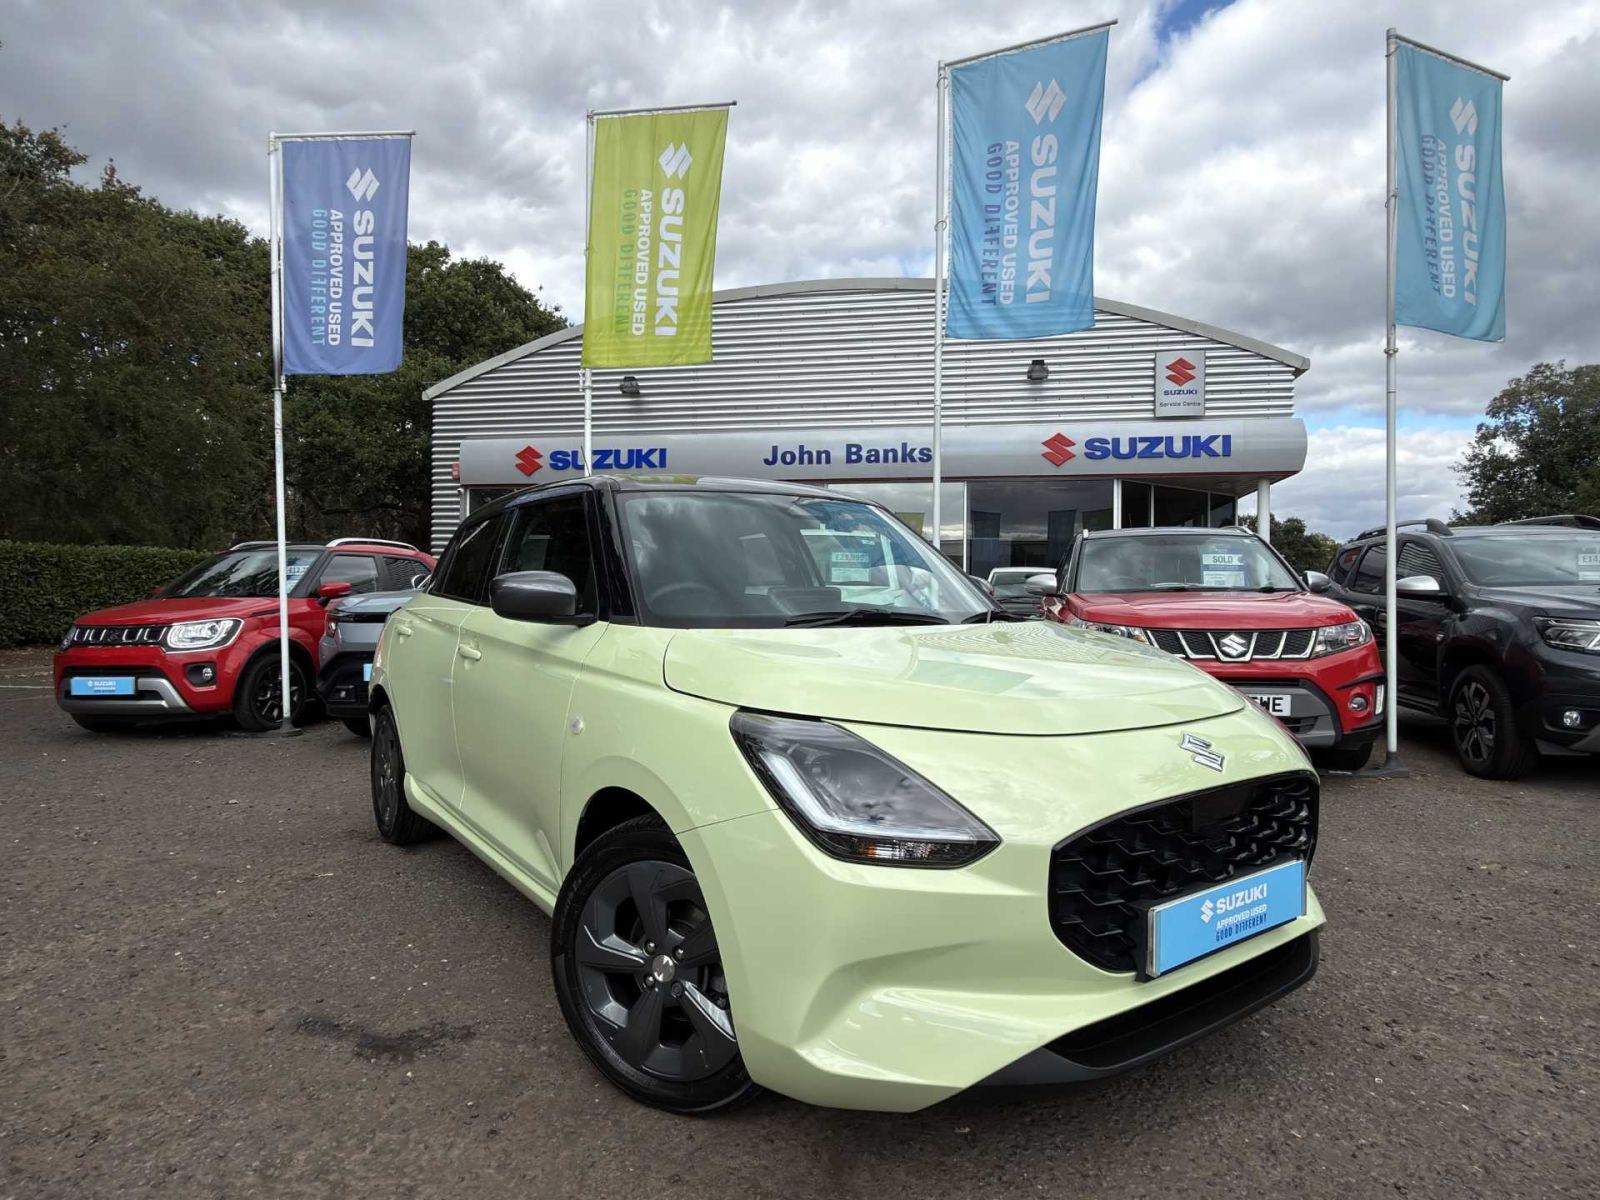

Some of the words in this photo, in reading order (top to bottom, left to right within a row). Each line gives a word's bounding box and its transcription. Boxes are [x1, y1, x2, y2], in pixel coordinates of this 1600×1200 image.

[985, 142, 1003, 194] GOOD
[1422, 134, 1436, 185] GOOD
[622, 189, 638, 235] GOOD
[1003, 140, 1020, 249] APPROVED
[1437, 139, 1454, 242] APPROVED
[311, 209, 328, 251] GOOD
[635, 189, 653, 284] APPROVED
[1026, 134, 1058, 303] SUZUKI
[1455, 144, 1478, 305] SUZUKI
[329, 209, 344, 299] APPROVED
[655, 188, 685, 336] SUZUKI
[981, 204, 1001, 306] DIFFERENT
[1425, 194, 1441, 296] DIFFERENT
[351, 210, 375, 347] SUZUKI
[615, 243, 635, 334] DIFFERENT
[1000, 253, 1017, 305] USED
[1440, 245, 1456, 299] USED
[311, 259, 327, 346] DIFFERENT
[328, 302, 342, 346] USED
[632, 288, 648, 336] USED
[549, 447, 667, 471] SUZUKI
[763, 445, 832, 466] John
[845, 442, 933, 465] Banks
[1084, 434, 1232, 460] SUZUKI
[1212, 555, 1233, 564] SOLD
[1216, 883, 1268, 914] SUZUKI
[1216, 910, 1250, 929] APPROVED
[1250, 903, 1268, 916] USED
[1215, 928, 1233, 942] GOOD
[1235, 914, 1268, 934] DIFFERENT
